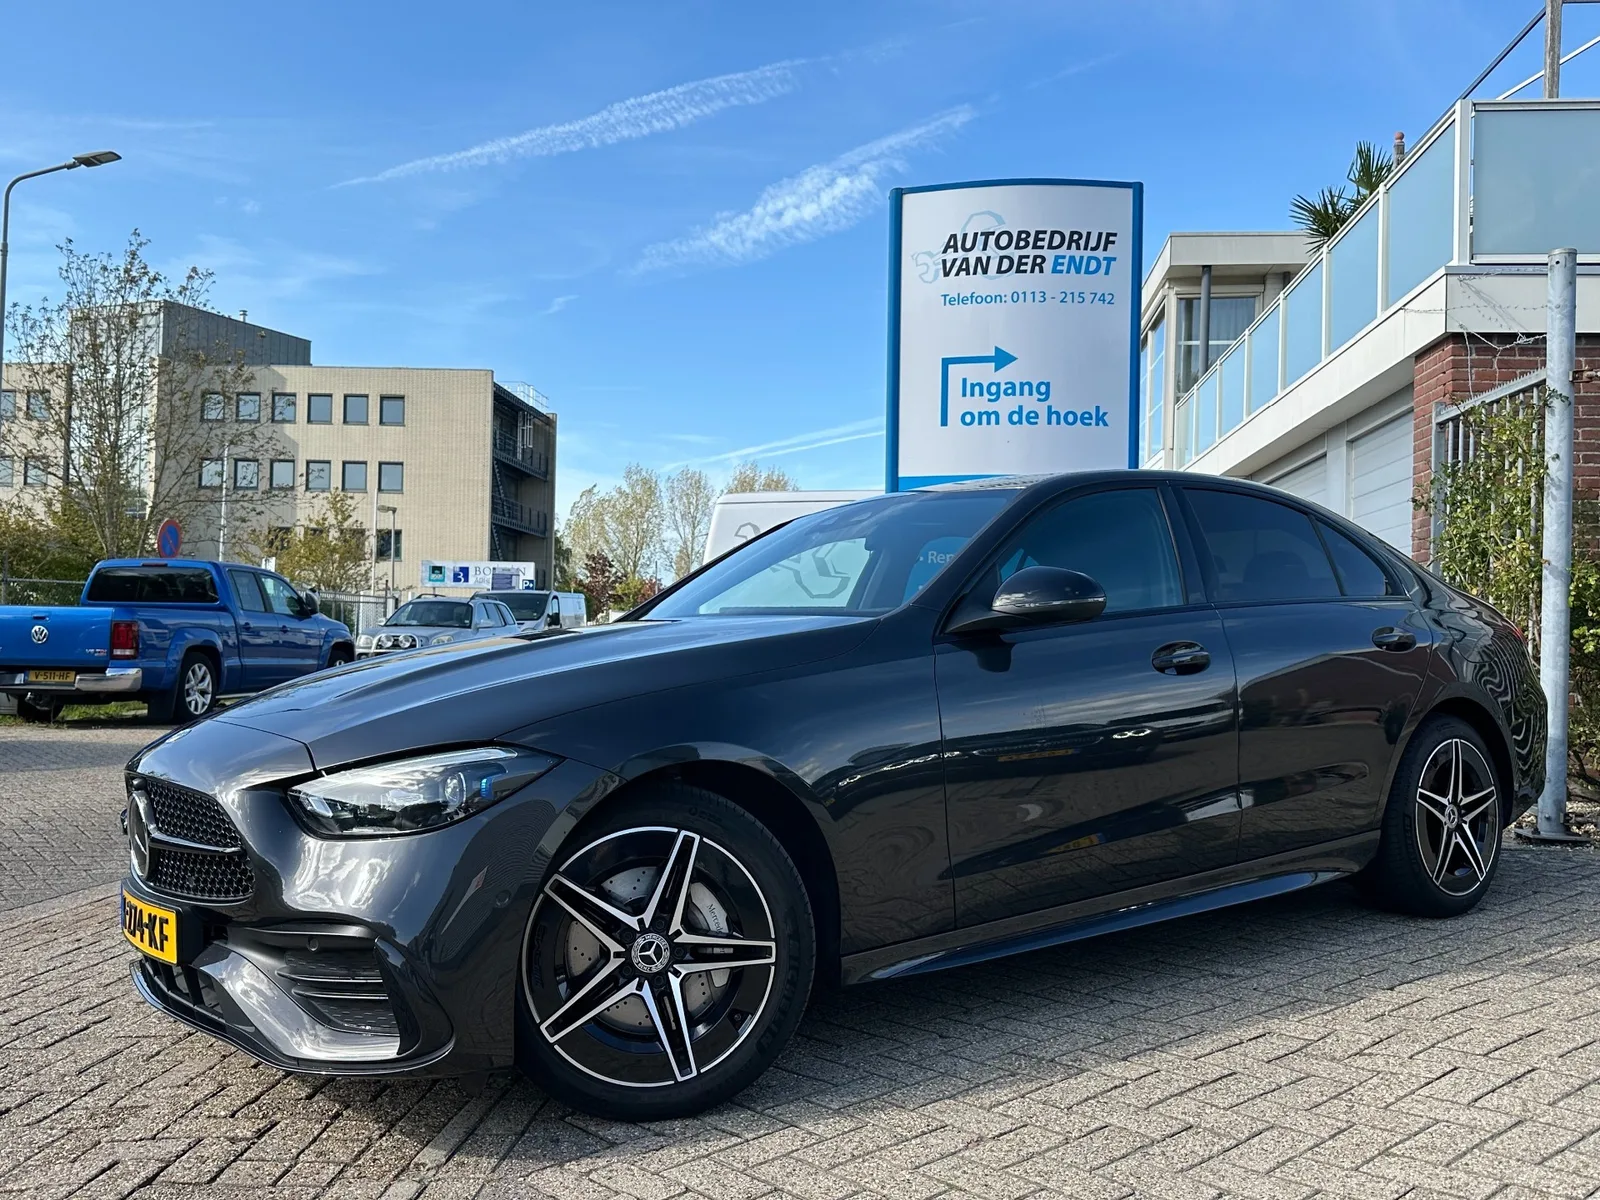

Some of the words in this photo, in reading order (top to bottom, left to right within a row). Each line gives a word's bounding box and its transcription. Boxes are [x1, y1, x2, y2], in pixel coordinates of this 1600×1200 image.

[942, 230, 1117, 254] AUTOBEDRIJF
[941, 256, 991, 278] VAN
[996, 255, 1046, 275] DER
[1051, 255, 1117, 276] ENDT
[941, 291, 1007, 306] Telefoon:
[1011, 291, 1046, 303] 0113
[1059, 291, 1085, 304] 215
[1090, 292, 1115, 305] 742
[961, 377, 1051, 402] Ingang
[960, 410, 1000, 426] om
[1008, 405, 1039, 425] de
[1047, 405, 1109, 426] hoek
[34, 671, 71, 680] V-511-HF
